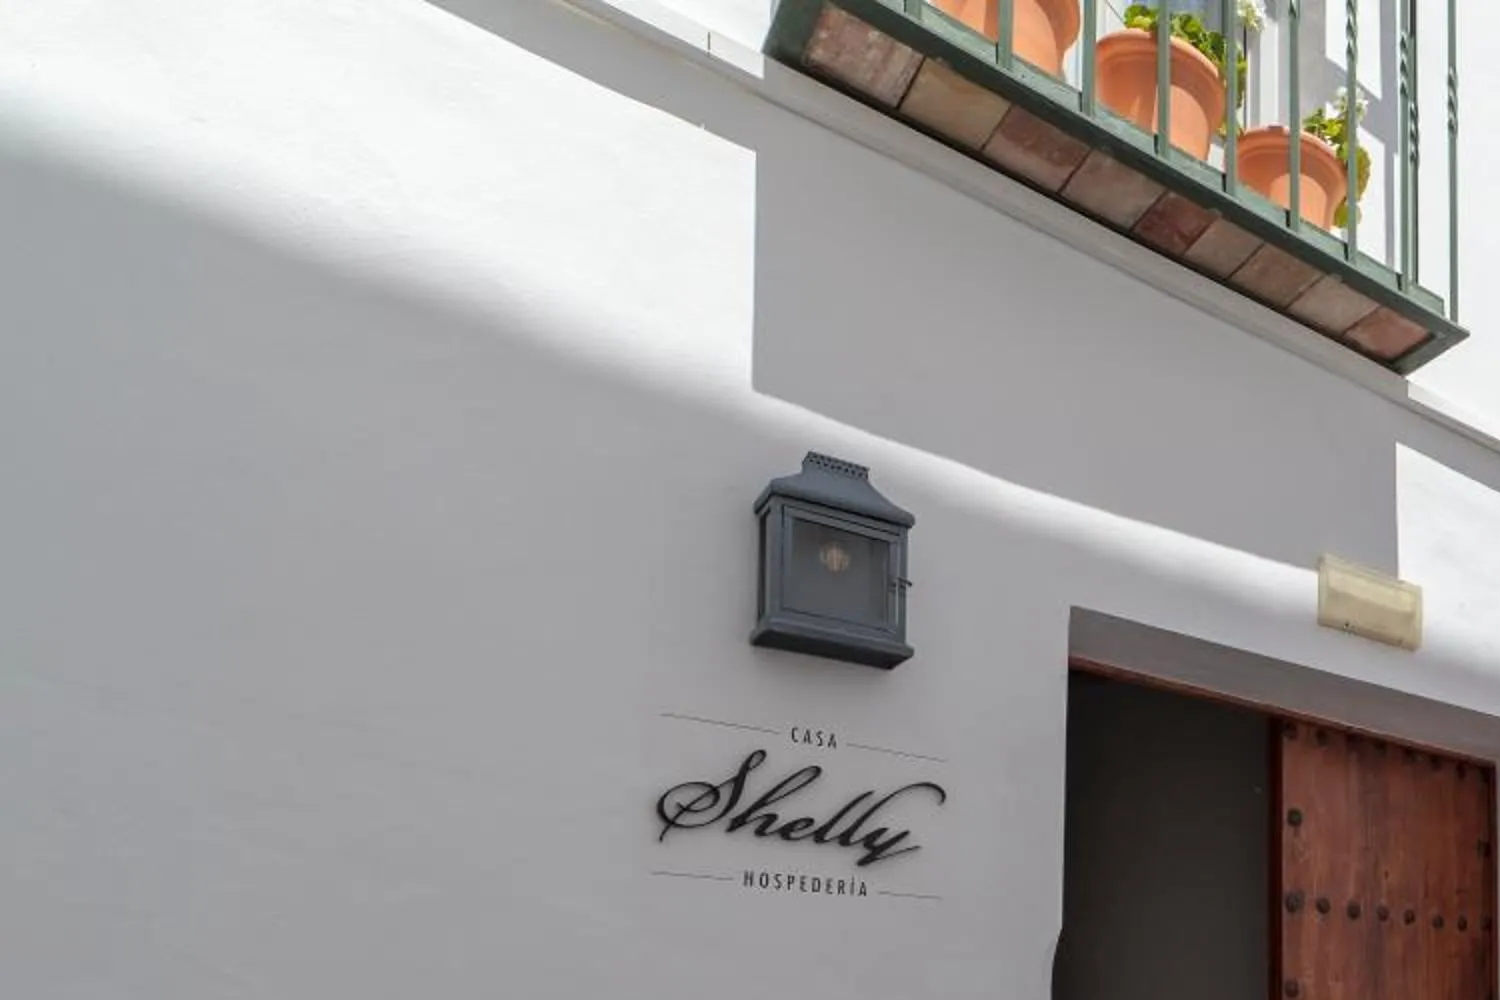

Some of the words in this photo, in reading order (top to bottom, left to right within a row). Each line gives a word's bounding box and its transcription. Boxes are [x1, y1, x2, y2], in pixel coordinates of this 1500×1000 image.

[790, 727, 838, 749] CASA
[656, 749, 947, 867] Shelly
[743, 871, 868, 897] HOSPEDERÍA
